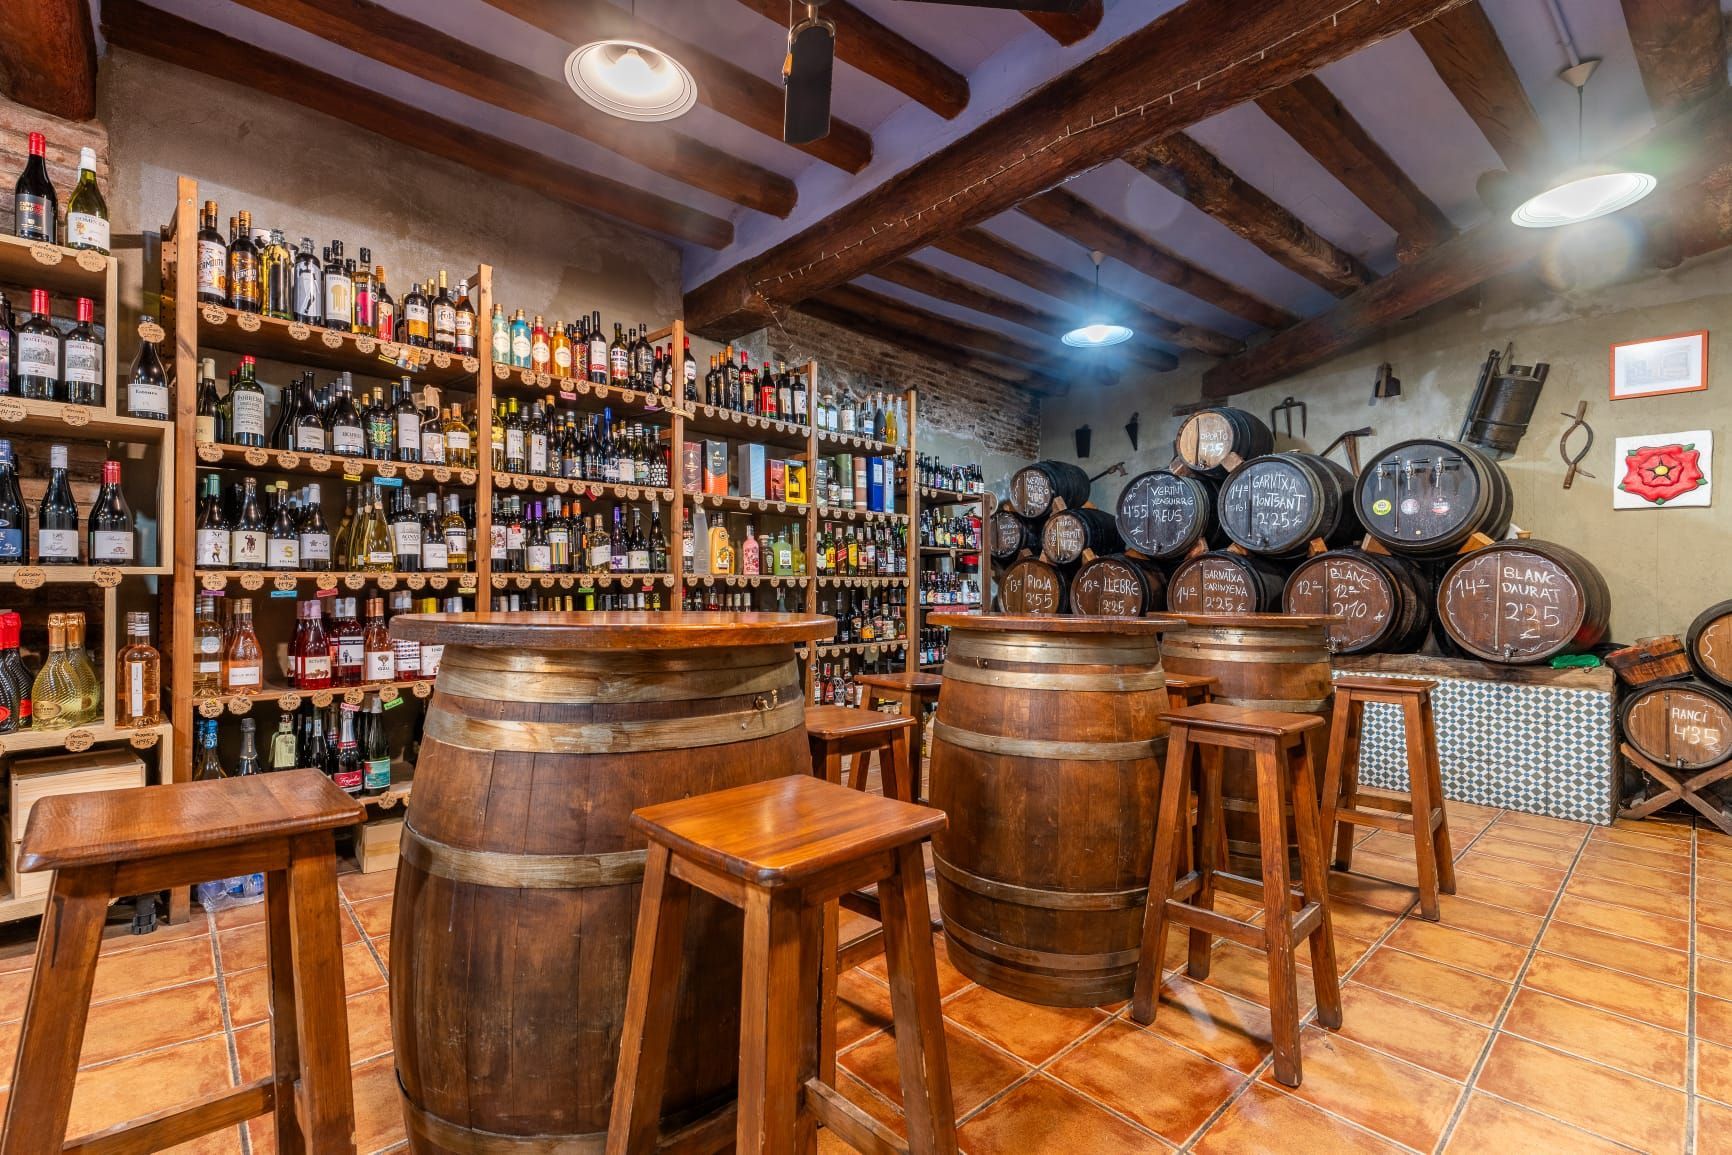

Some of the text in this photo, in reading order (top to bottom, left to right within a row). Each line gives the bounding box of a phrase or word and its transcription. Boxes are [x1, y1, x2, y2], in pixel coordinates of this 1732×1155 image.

[1252, 492, 1307, 512] MONTSANT
[1152, 509, 1183, 522] REUS
[1256, 512, 1289, 528] 2'25
[1027, 574, 1052, 591] RIOJA
[1204, 568, 1245, 584] GARNATXA
[1330, 567, 1372, 590] BLANC
[1503, 566, 1556, 585] BLANC
[1104, 576, 1139, 596] LLEBRE
[1502, 582, 1561, 603] DAURAT
[1332, 601, 1367, 618] 2'10
[1505, 602, 1560, 627] 2'25
[1674, 722, 1719, 747] 4'35
